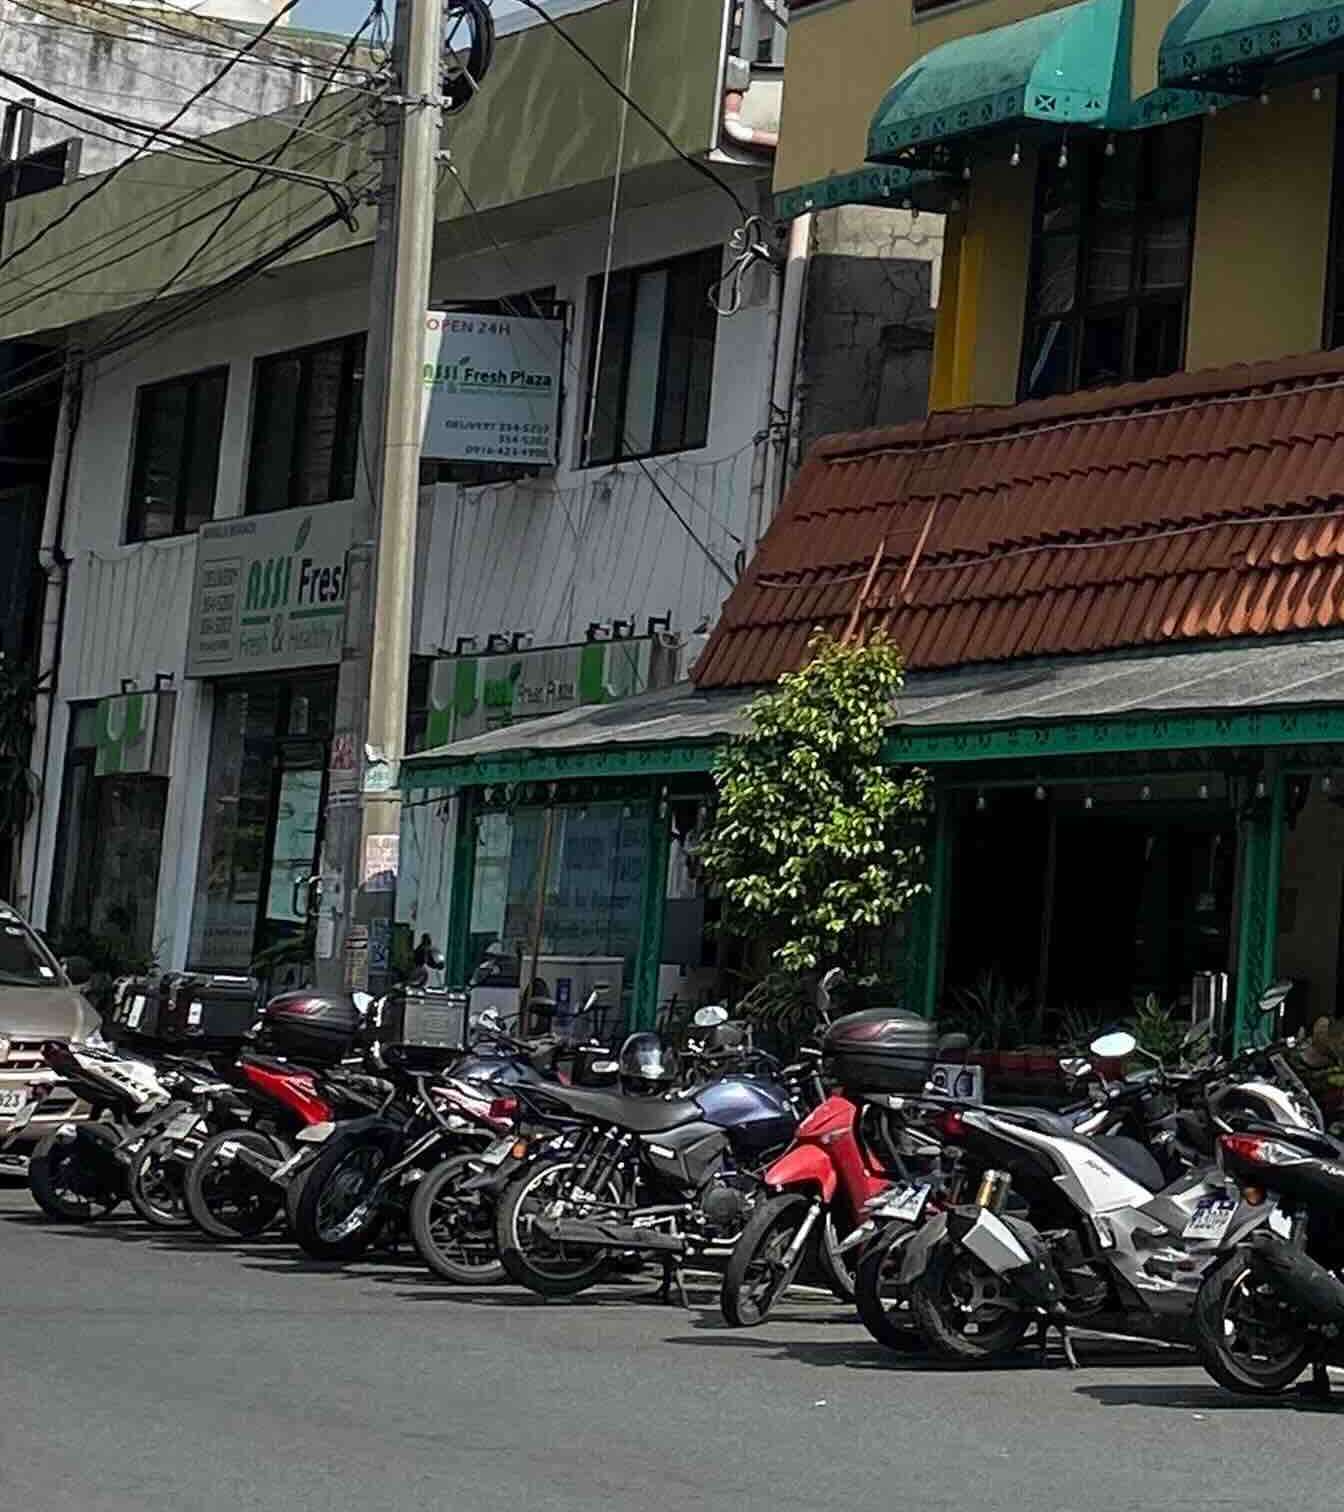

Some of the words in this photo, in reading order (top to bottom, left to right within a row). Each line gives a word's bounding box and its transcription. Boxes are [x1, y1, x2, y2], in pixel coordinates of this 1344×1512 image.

[426, 318, 474, 334] OPEN
[479, 320, 511, 336] 24H
[464, 366, 507, 385] Fresh
[510, 369, 552, 387] Plaza
